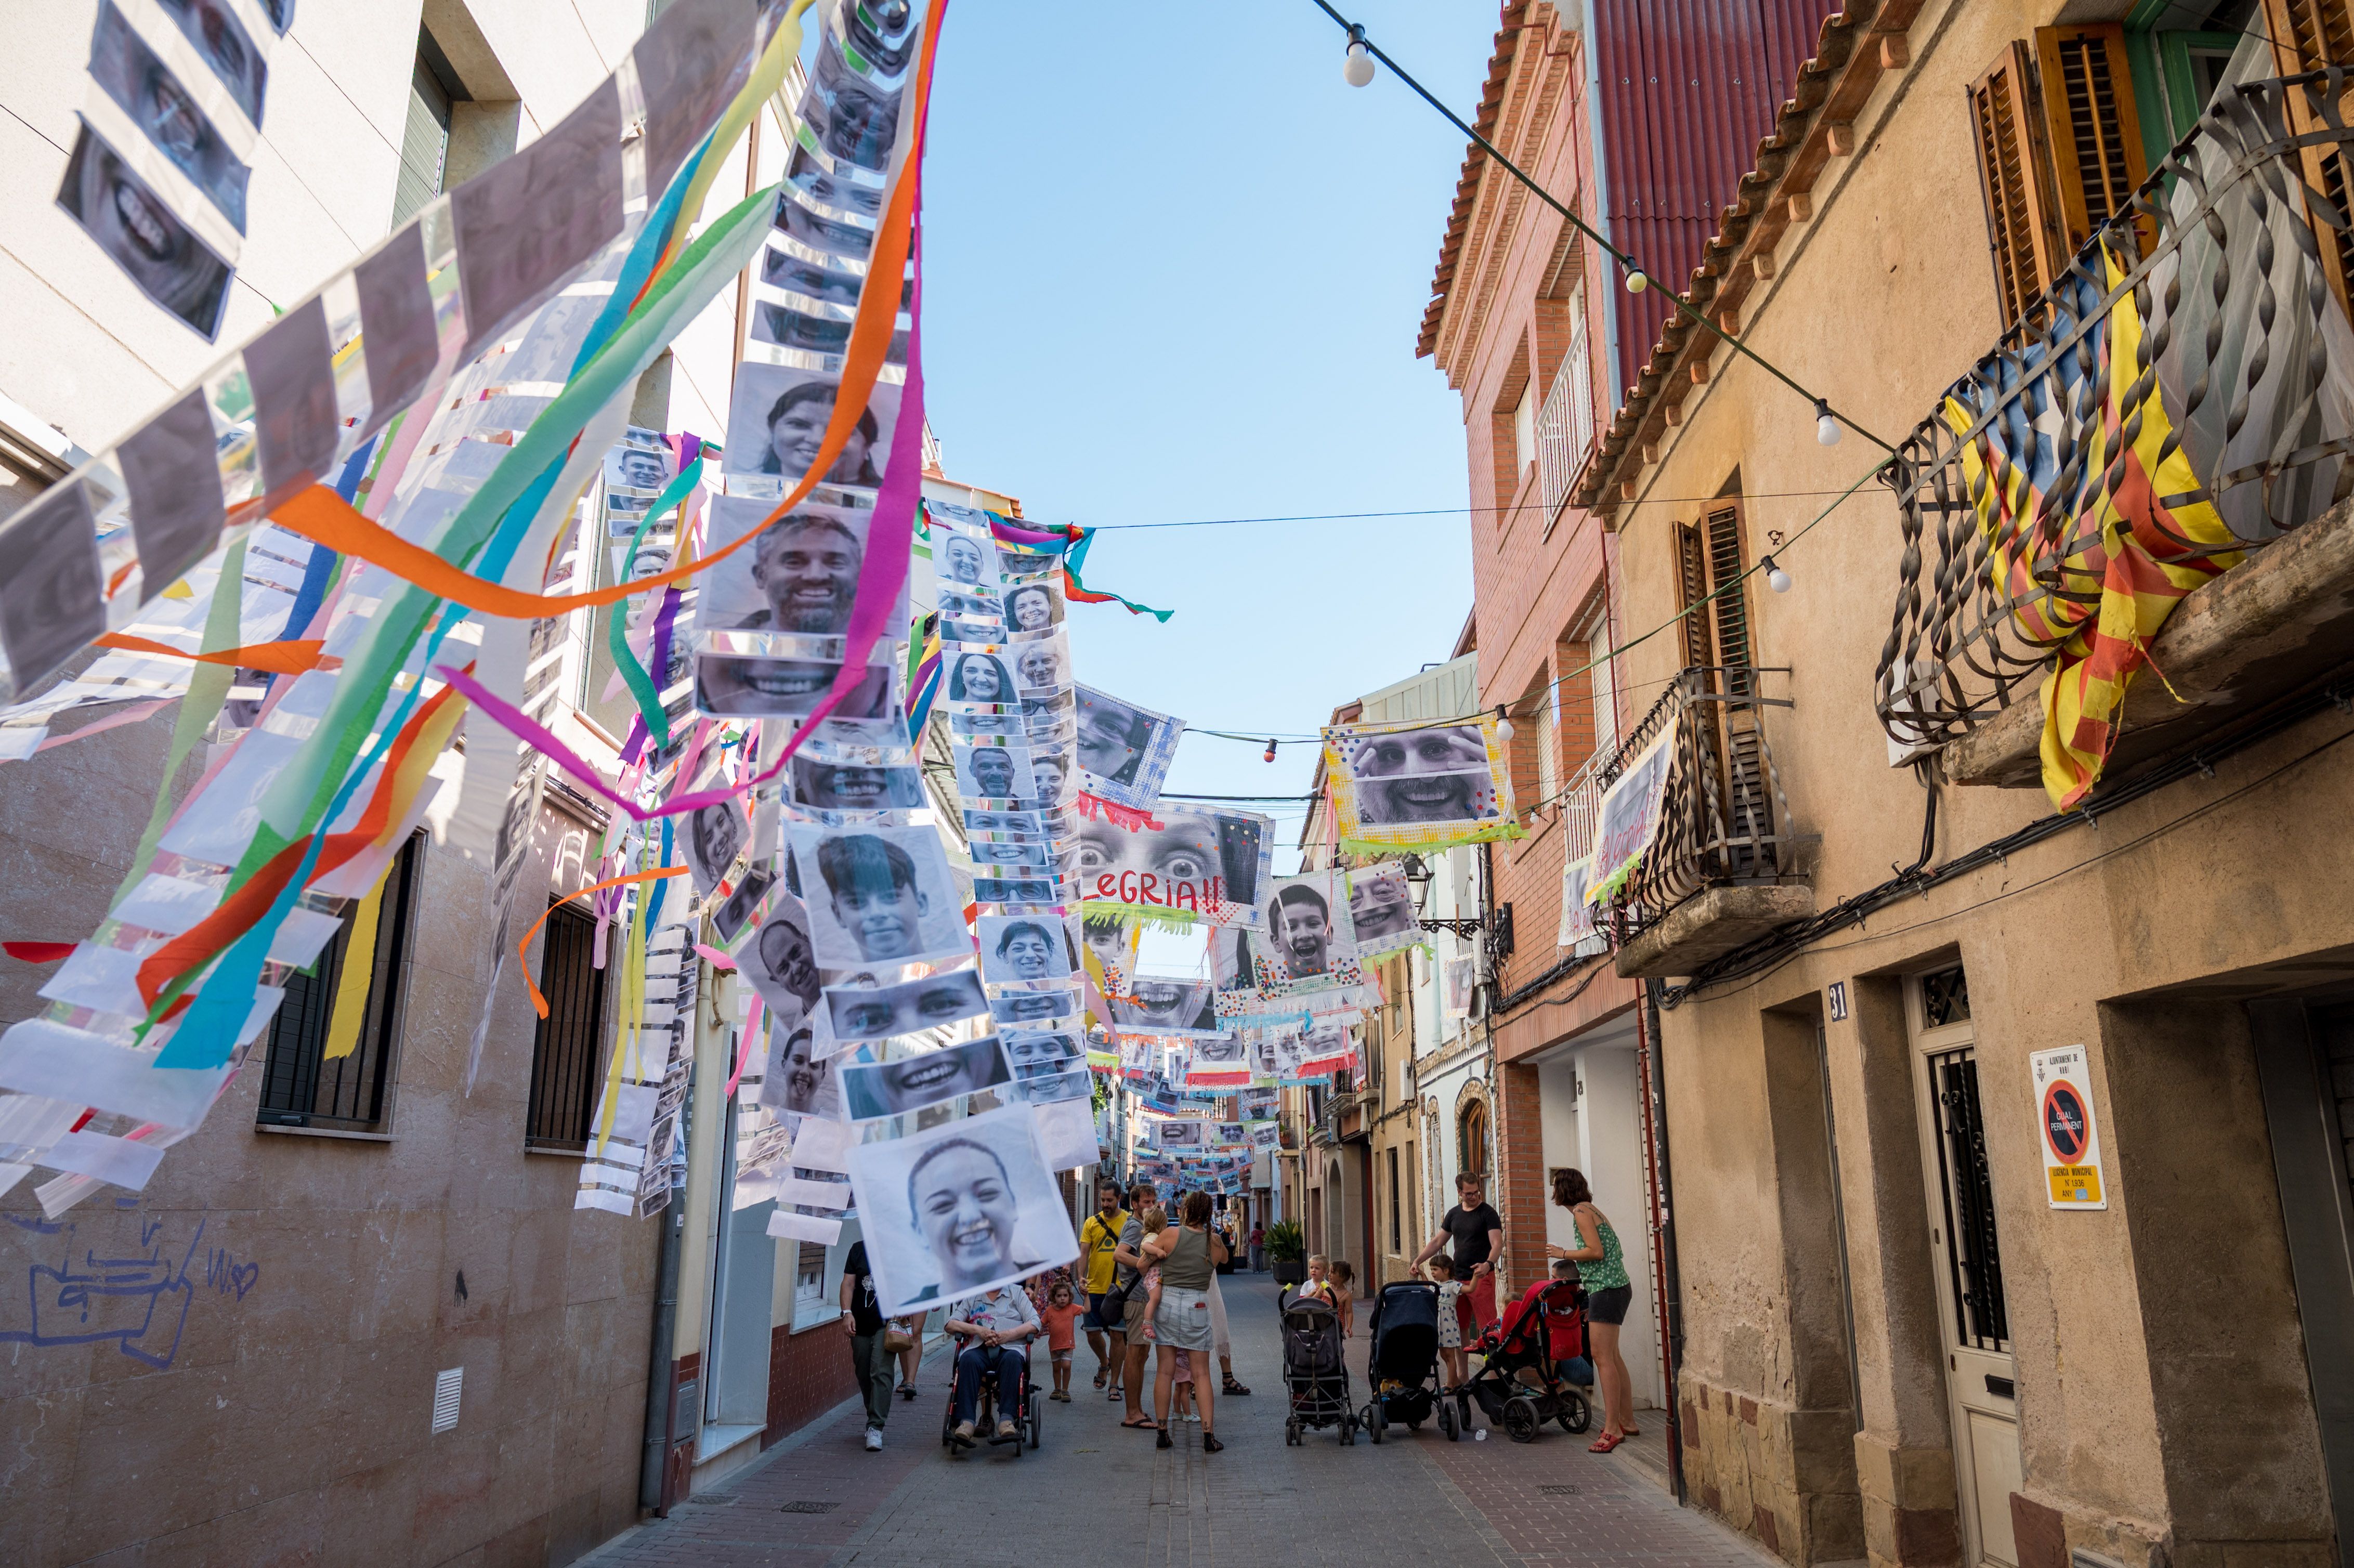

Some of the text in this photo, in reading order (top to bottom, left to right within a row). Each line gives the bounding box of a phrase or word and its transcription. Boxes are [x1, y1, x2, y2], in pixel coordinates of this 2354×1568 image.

[1829, 985, 1846, 1018] 31
[2049, 1053, 2078, 1065] AJUNTAMENT DE
[2056, 1111, 2073, 1120] GUAL
[2050, 1121, 2082, 1131] PERMANENT
[2071, 1167, 2092, 1176] MUNICIPAL
